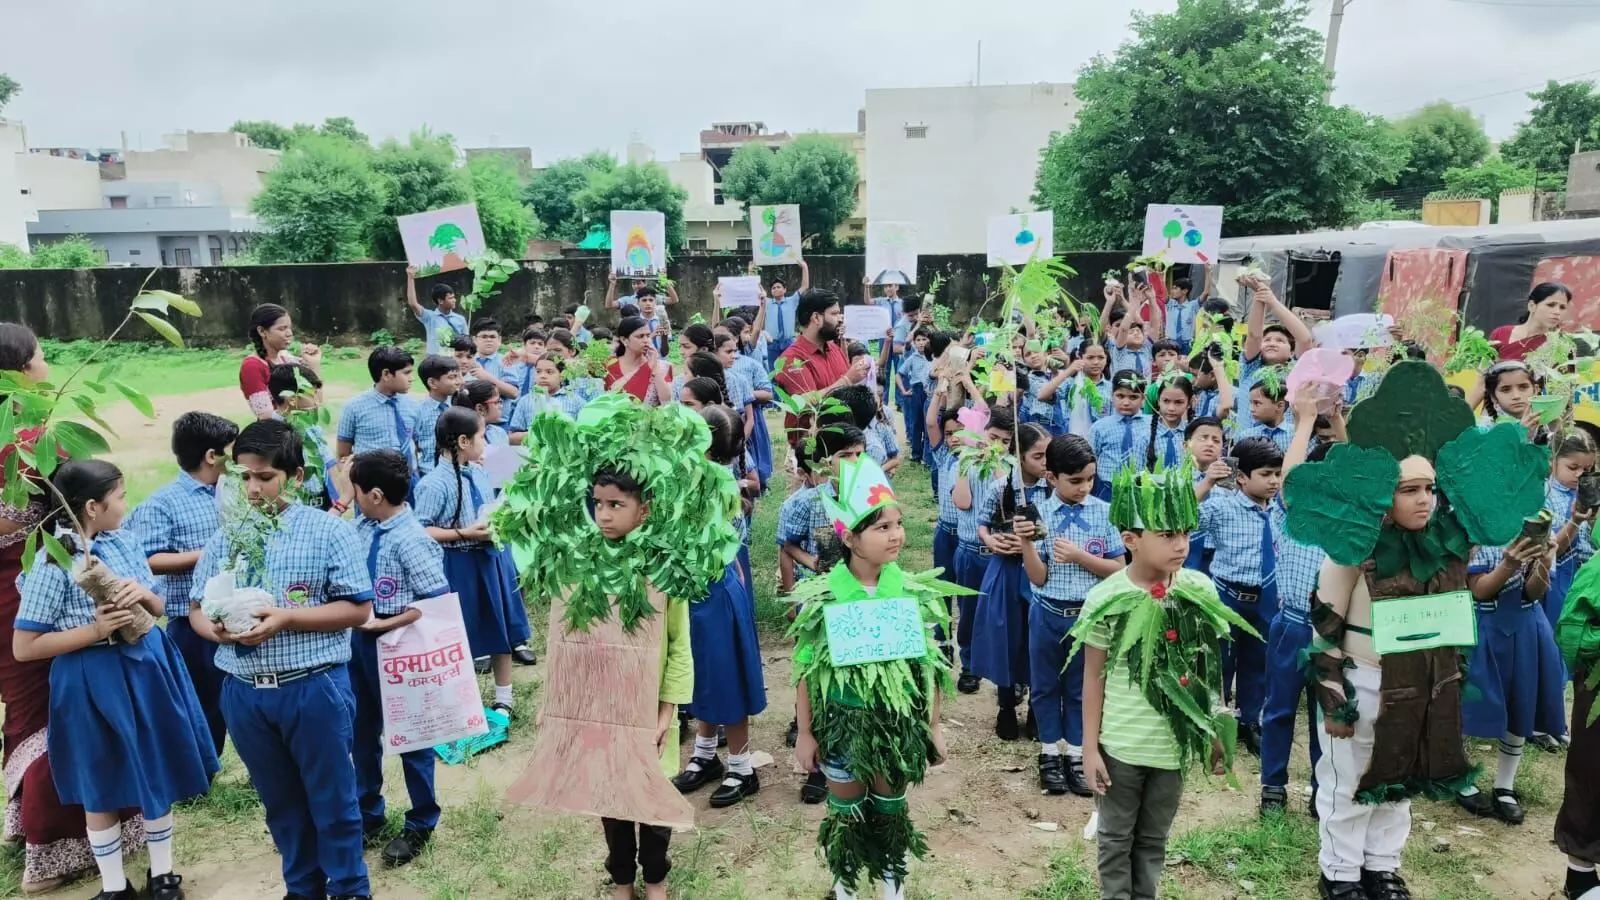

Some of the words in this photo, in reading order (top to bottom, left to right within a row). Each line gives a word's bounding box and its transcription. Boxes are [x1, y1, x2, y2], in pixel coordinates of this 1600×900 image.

[881, 600, 916, 617] SAVE
[836, 645, 864, 663] SAVE
[865, 643, 884, 657] THE
[382, 642, 465, 685] कुमावत
